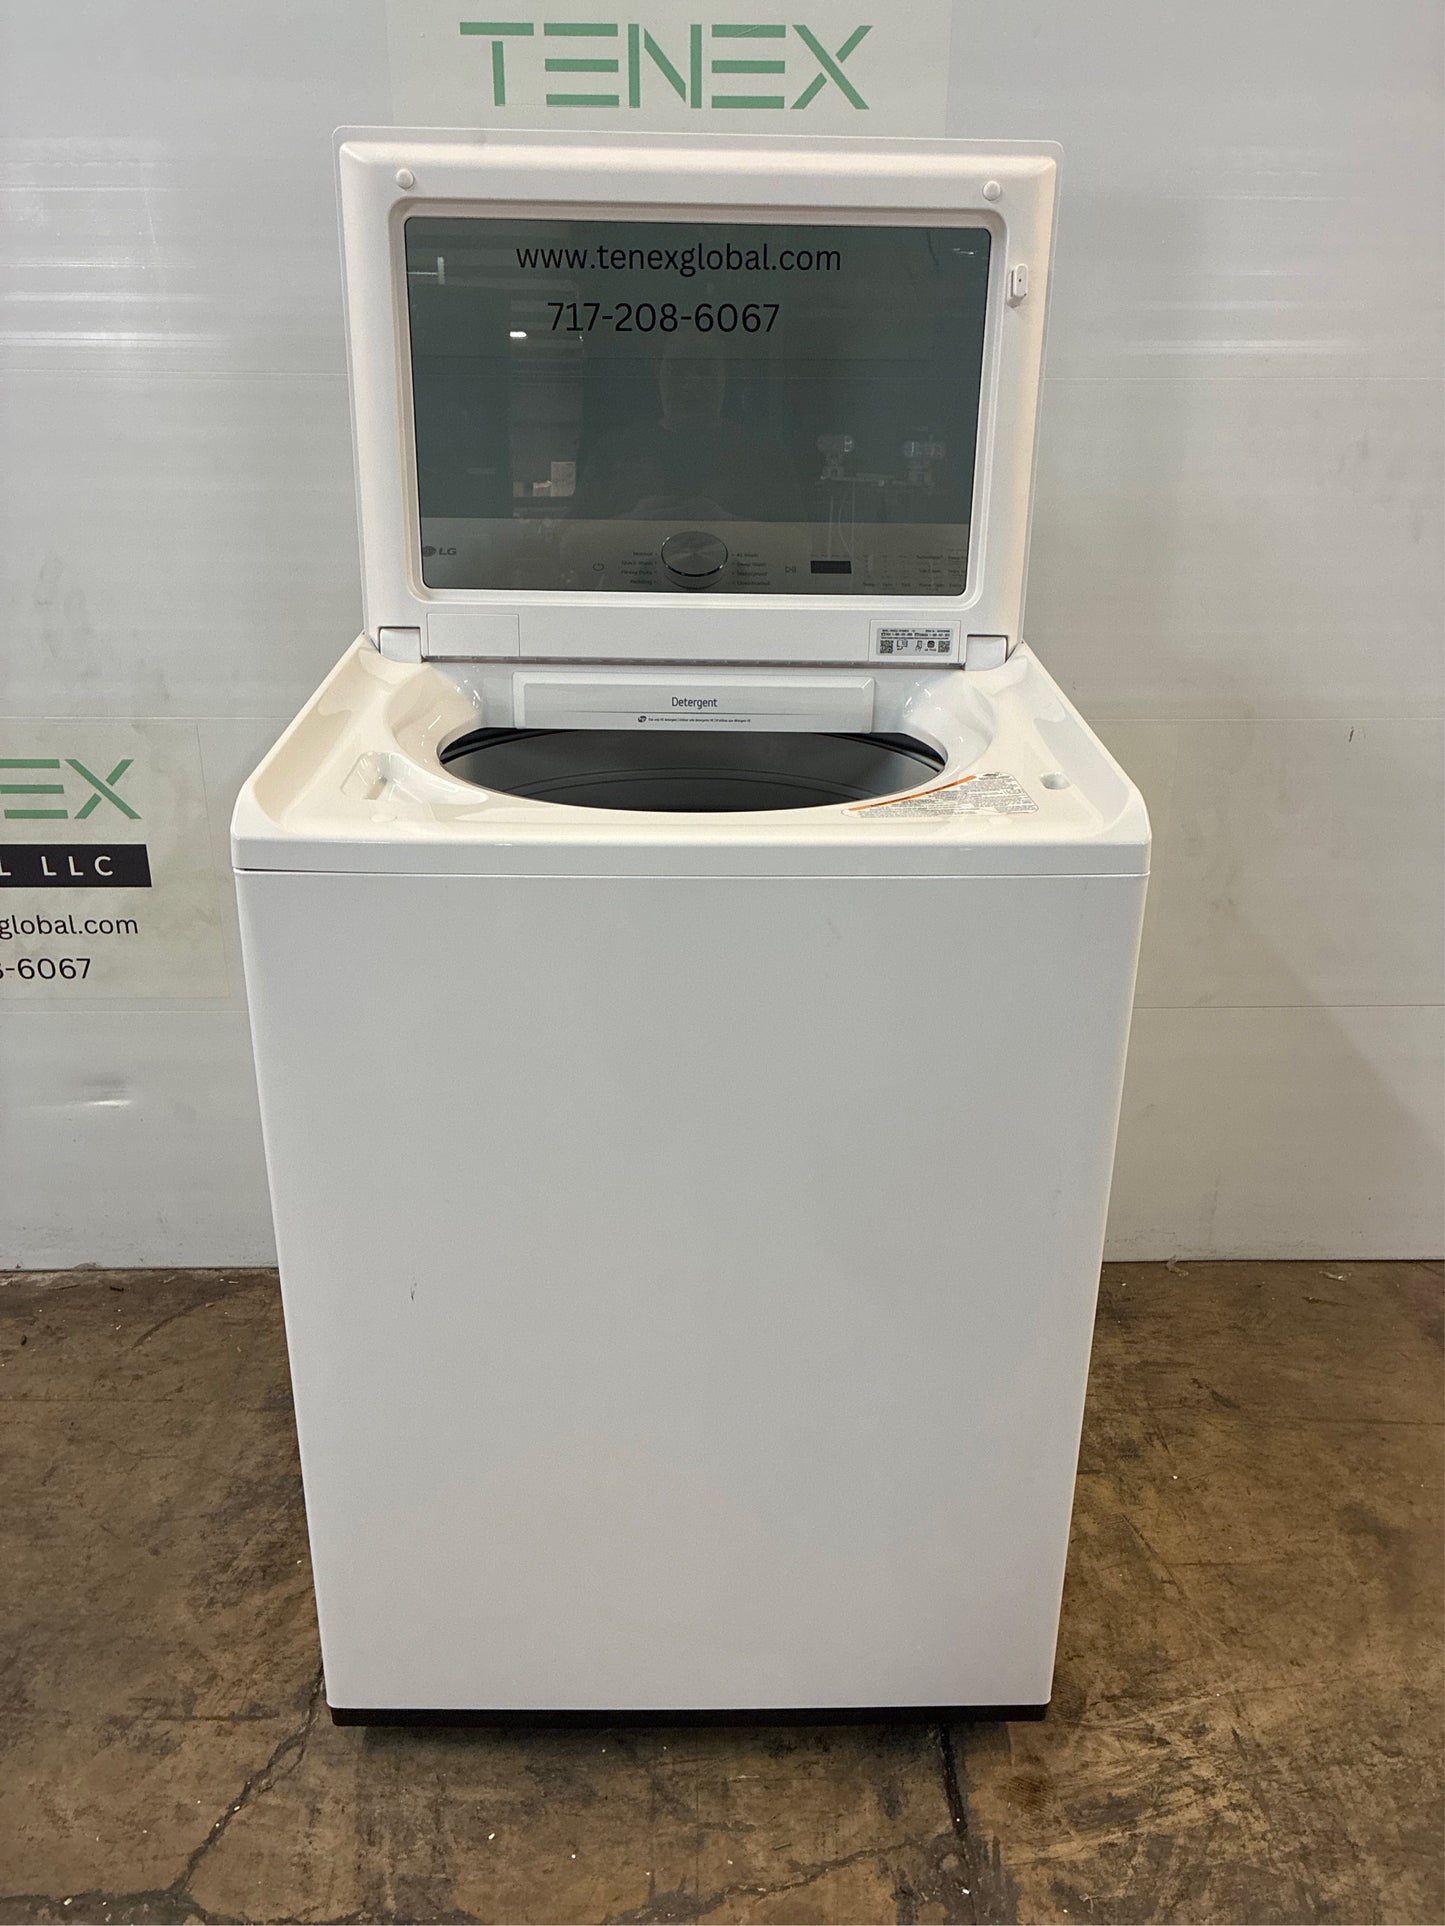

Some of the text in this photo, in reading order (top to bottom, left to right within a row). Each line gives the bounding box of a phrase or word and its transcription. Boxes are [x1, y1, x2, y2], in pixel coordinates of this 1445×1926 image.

[460, 22, 873, 110] TENEX
[516, 243, 841, 277] www.tenexglobal.com
[547, 302, 780, 332] 717-208-6067
[439, 547, 457, 556] LG
[671, 697, 718, 709] Detergent
[41, 856, 113, 876] LLC
[0, 958, 91, 980] -6067
